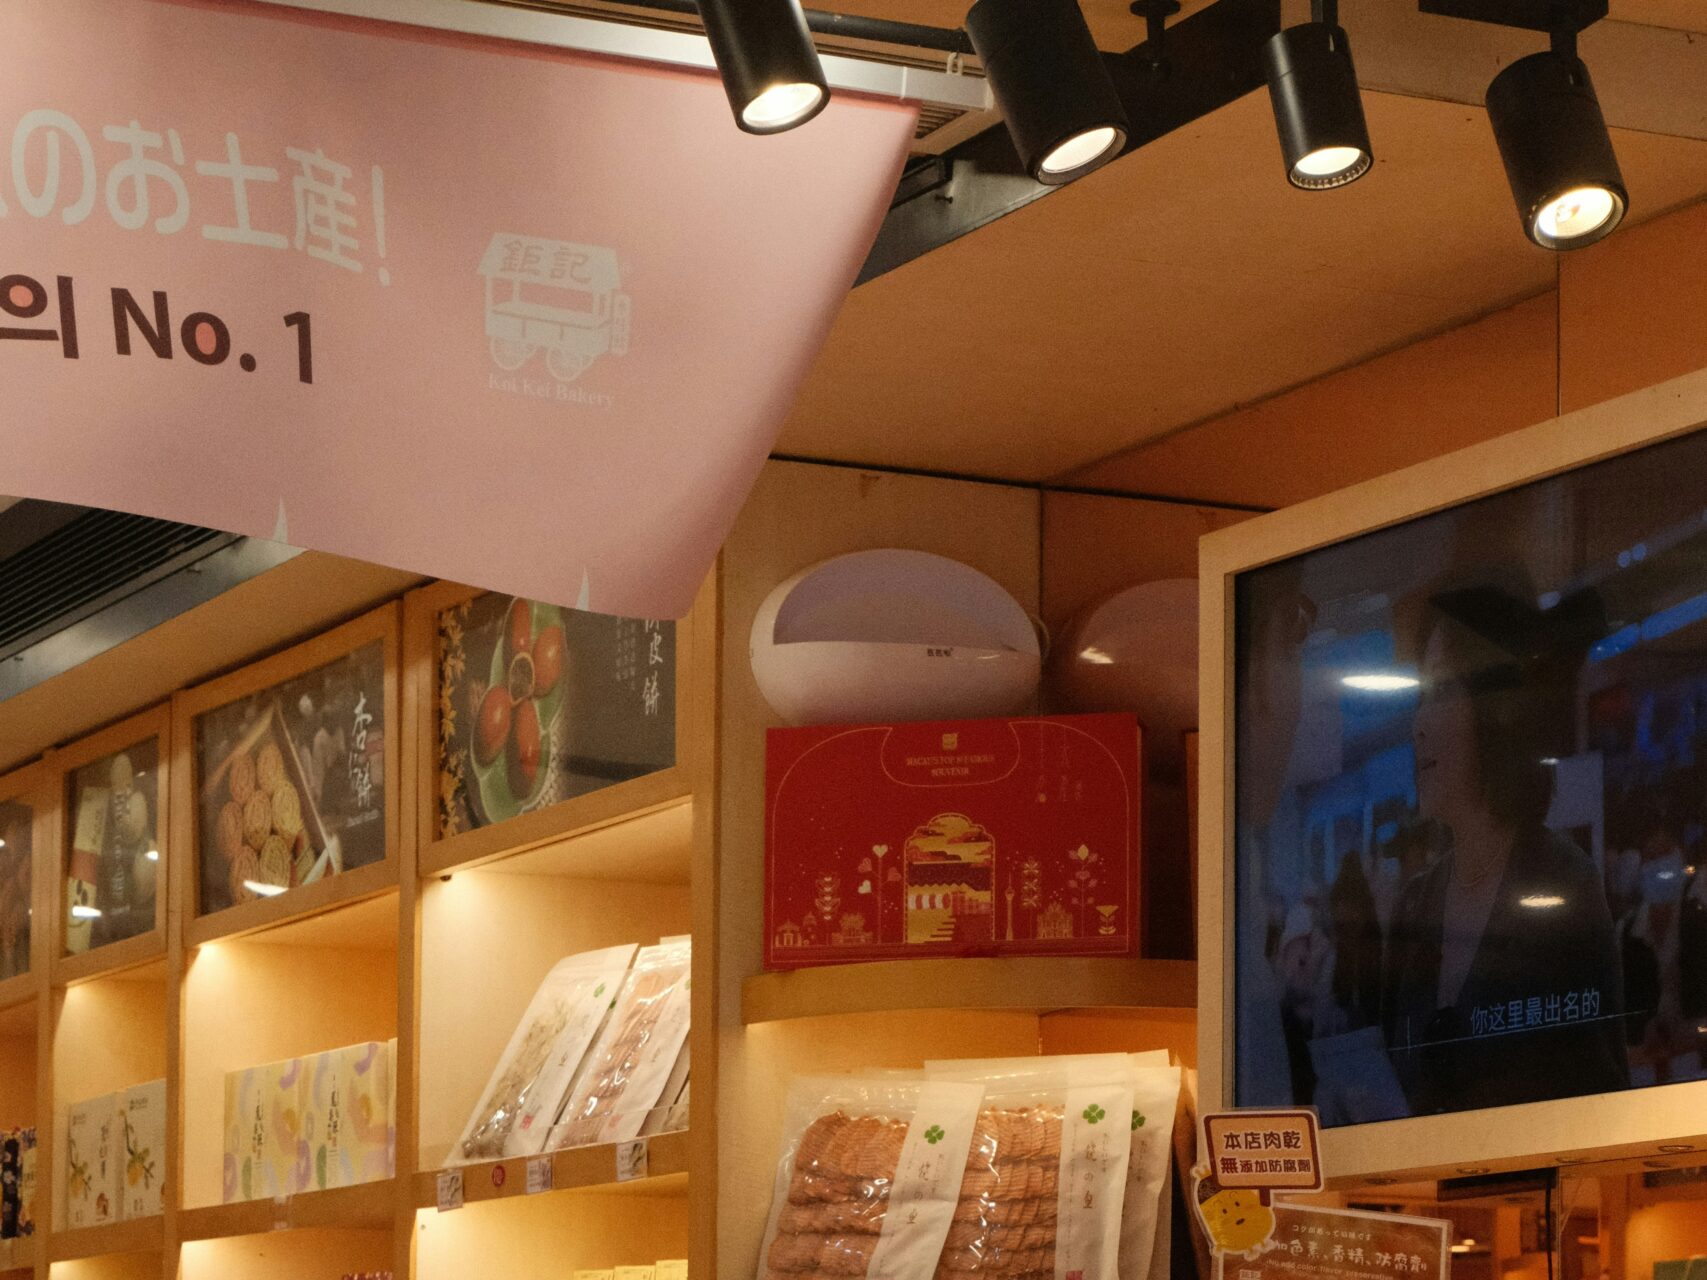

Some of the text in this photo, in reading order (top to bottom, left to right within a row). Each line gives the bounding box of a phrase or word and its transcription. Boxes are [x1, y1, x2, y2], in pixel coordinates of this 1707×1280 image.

[0, 108, 391, 287] のお土産!
[499, 240, 592, 285] 鉅記
[110, 287, 257, 373] No.
[283, 311, 313, 385] 1
[1470, 986, 1600, 1035] 你这里最出名的
[1223, 1130, 1302, 1150] 本店肉乾
[1219, 1157, 1312, 1174] 無添加防腐劑
